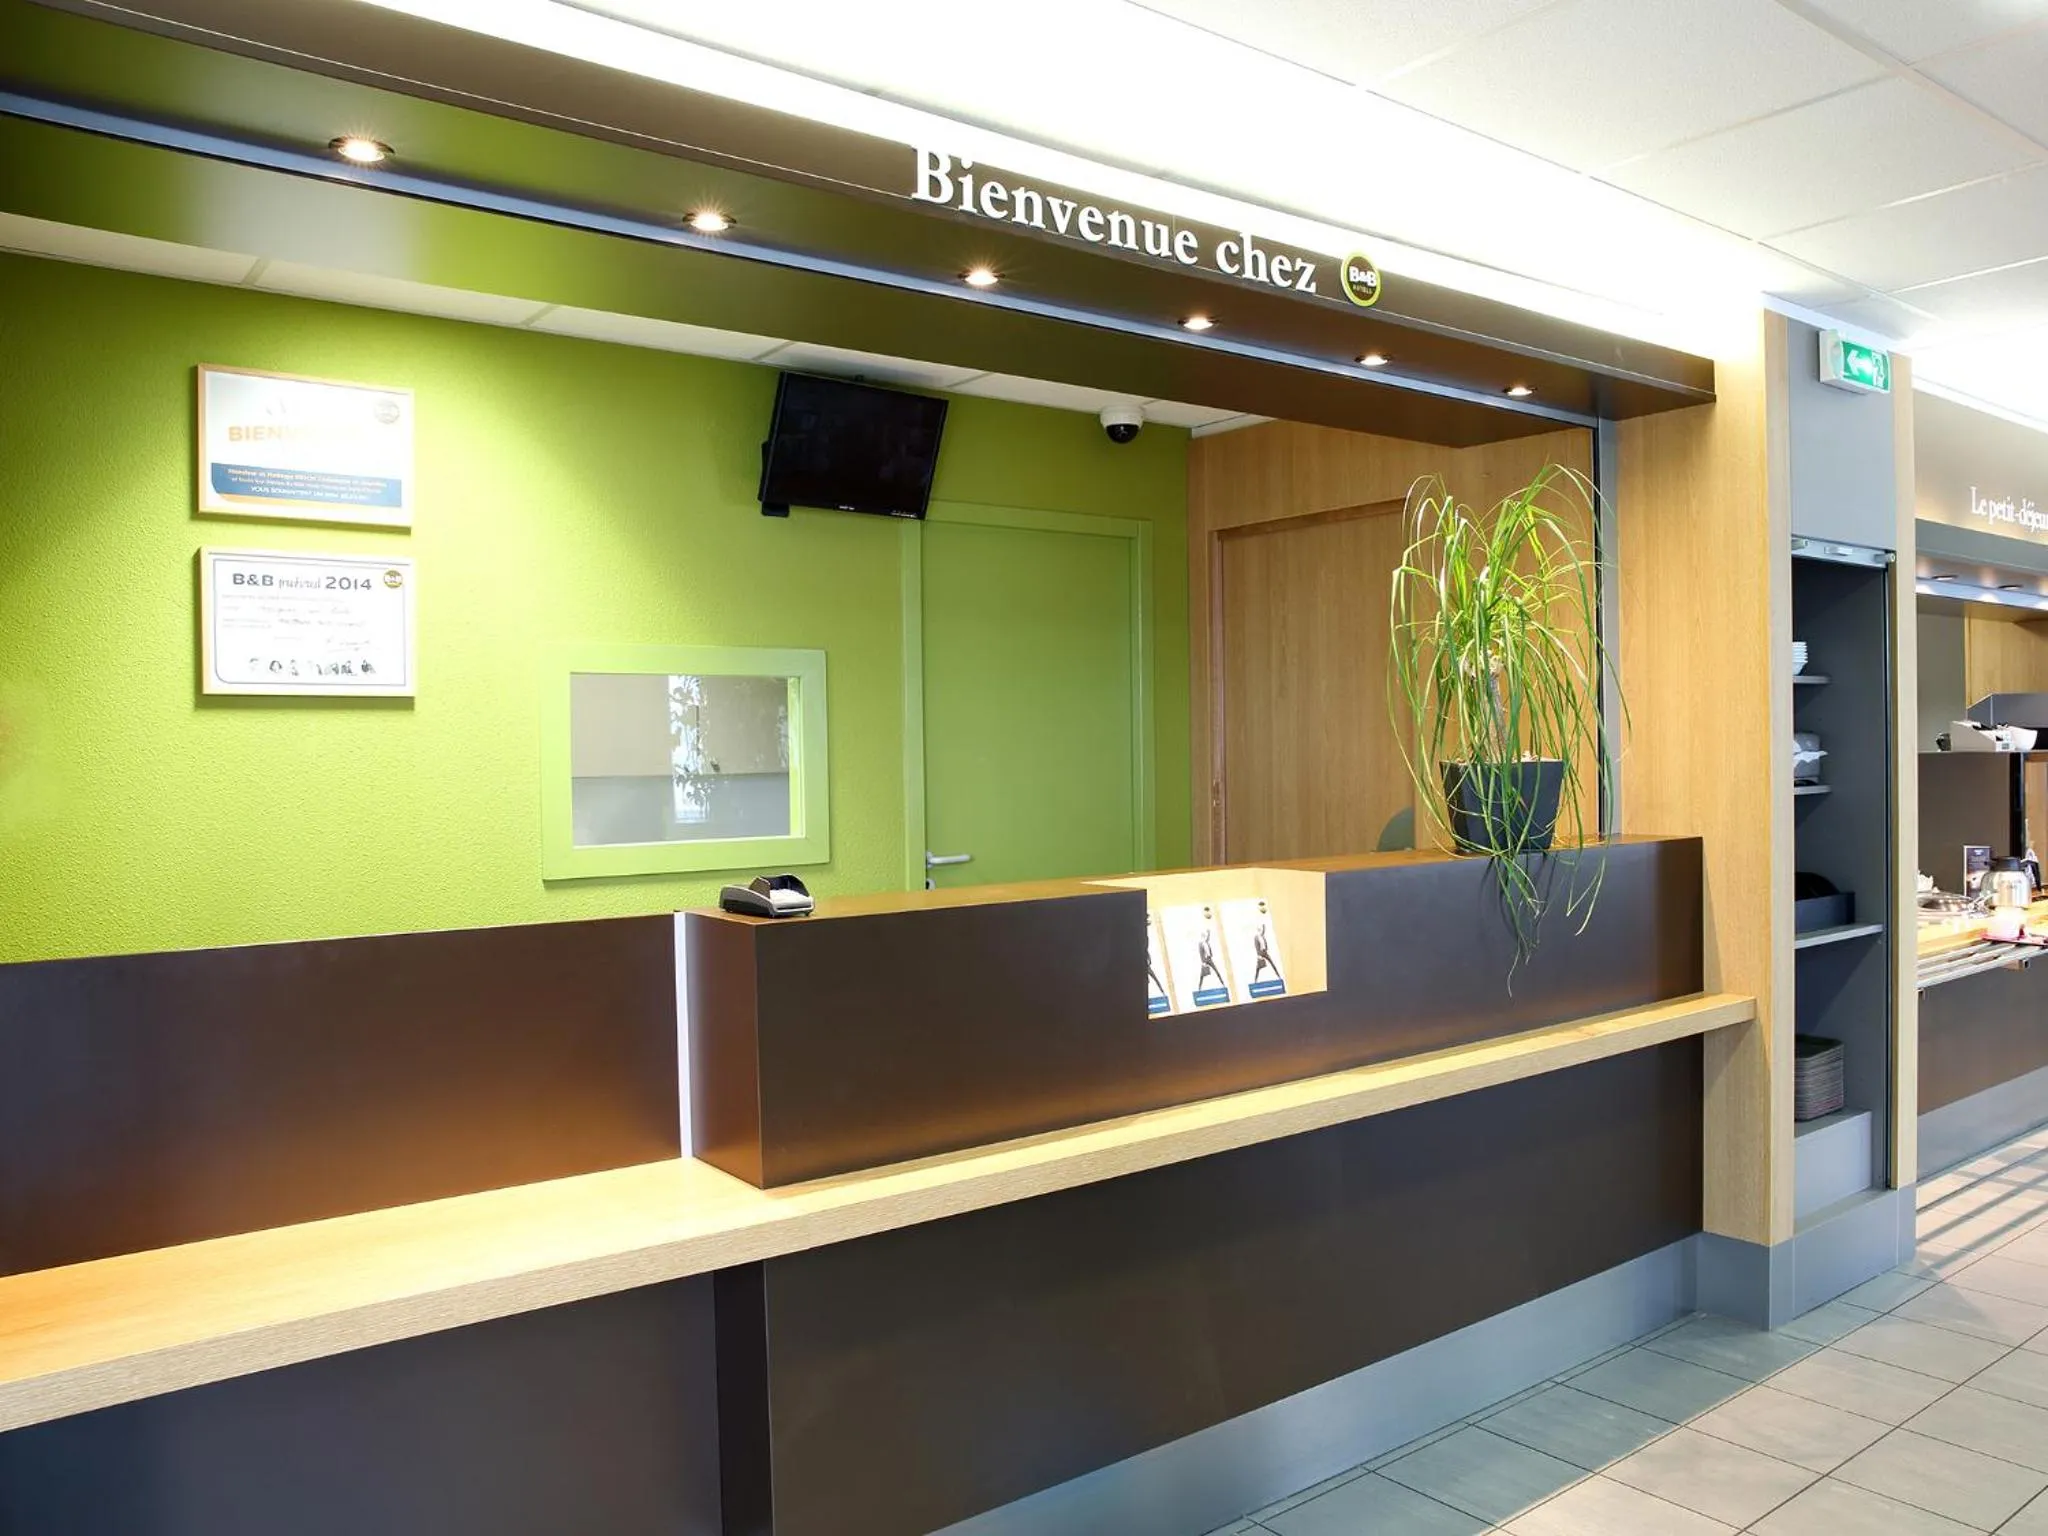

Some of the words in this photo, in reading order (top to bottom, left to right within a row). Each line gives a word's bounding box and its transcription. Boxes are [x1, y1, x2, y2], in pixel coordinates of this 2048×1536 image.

[912, 143, 1199, 265] Bienvenue
[1216, 231, 1317, 293] chez
[1349, 265, 1377, 287] B&B
[1970, 487, 1987, 516] Le
[232, 572, 274, 587] B&B
[325, 576, 372, 591] 2014
